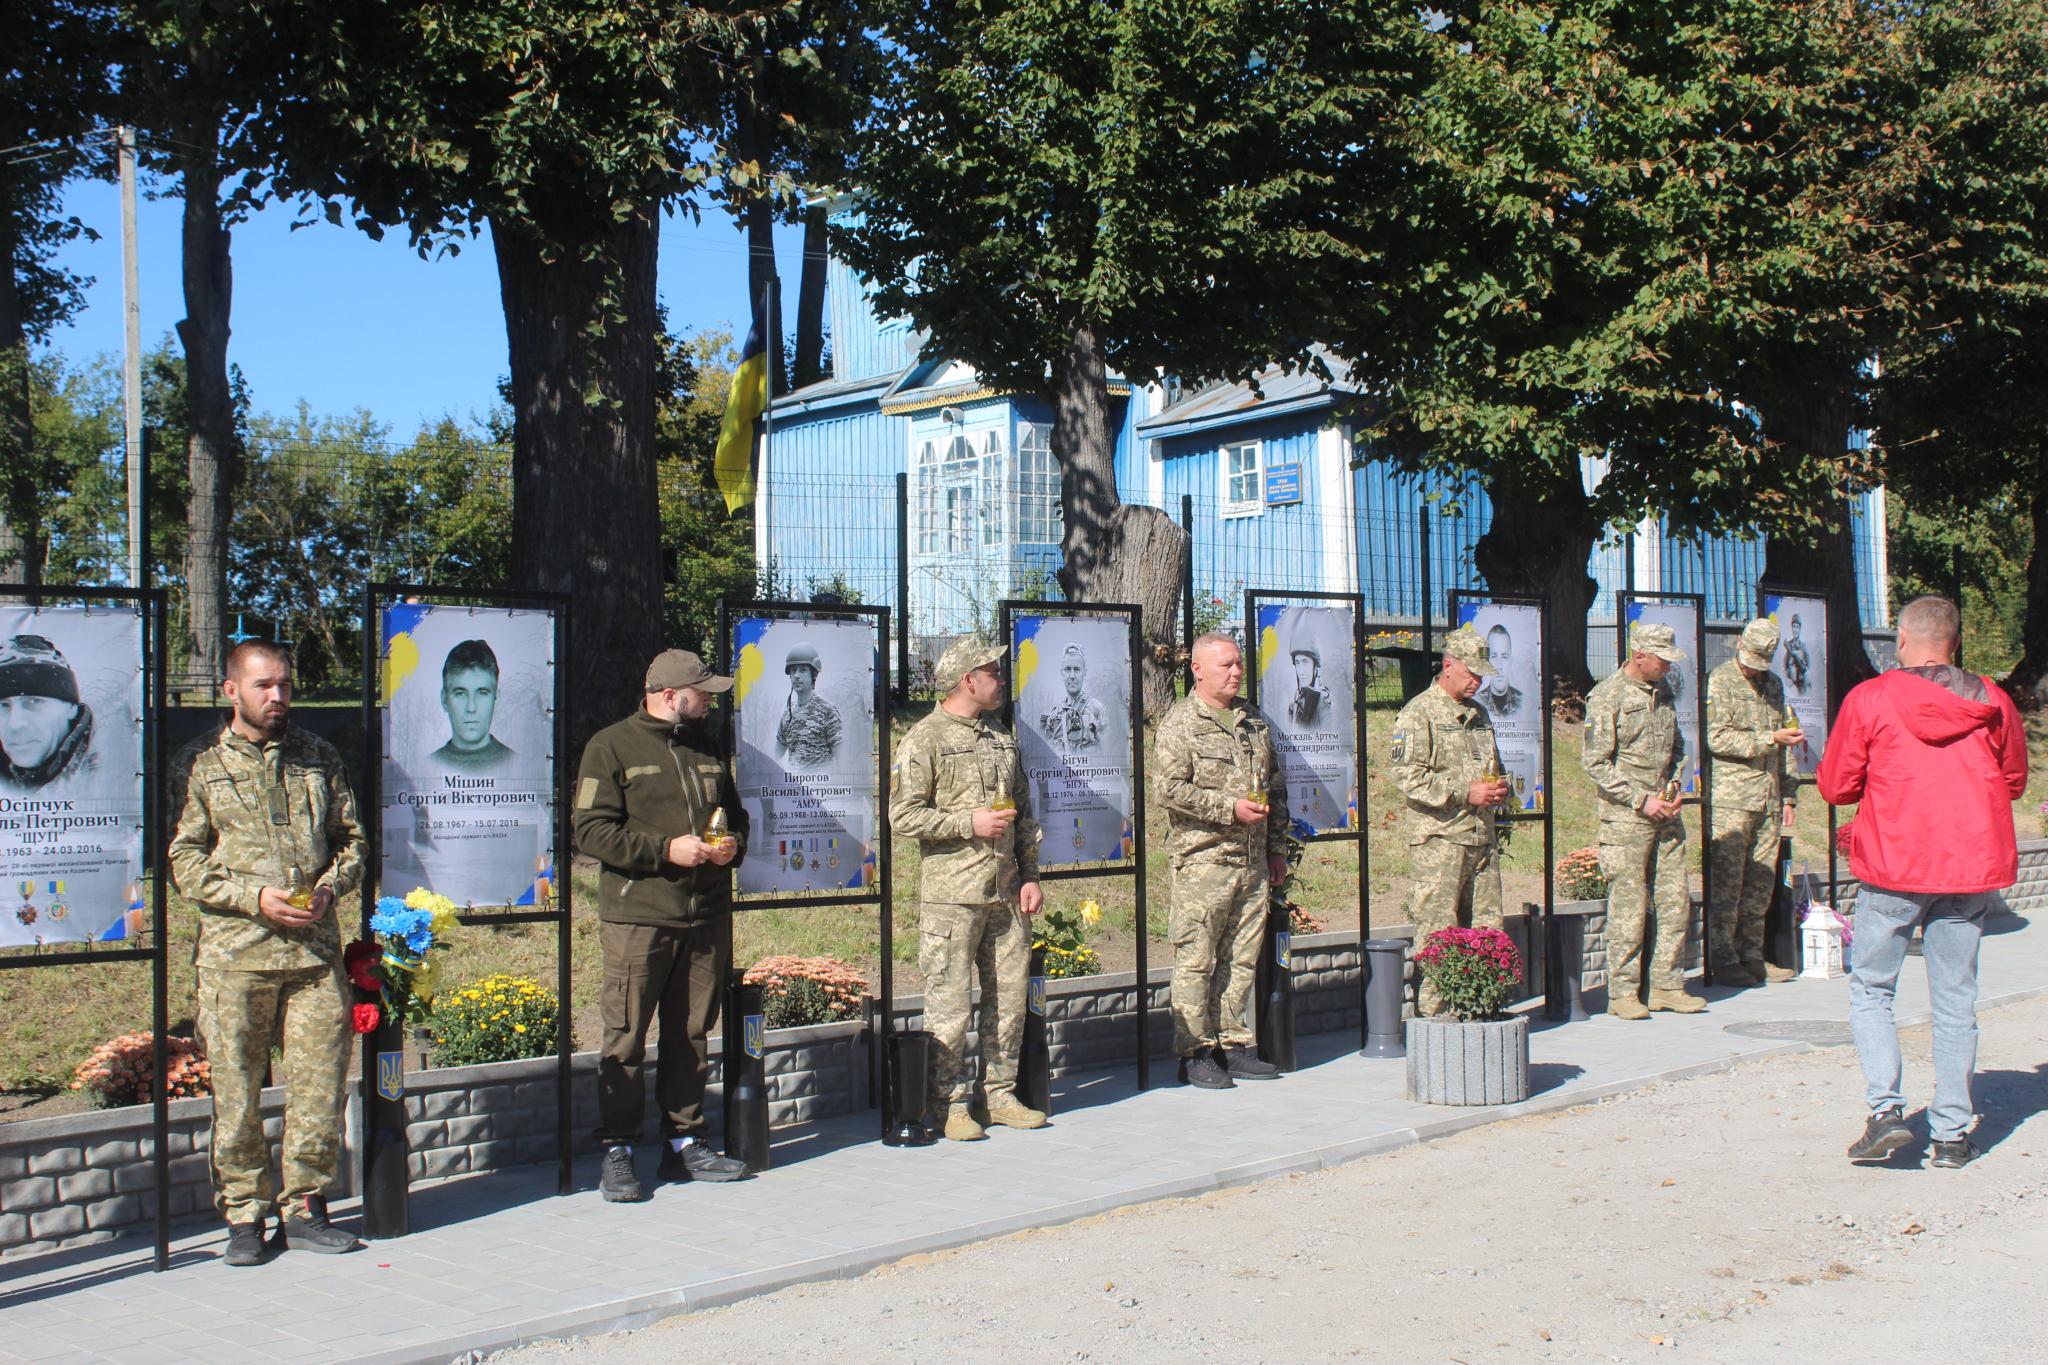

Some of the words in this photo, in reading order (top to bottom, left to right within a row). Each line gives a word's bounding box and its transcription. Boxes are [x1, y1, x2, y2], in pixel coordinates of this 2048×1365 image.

[1491, 721, 1516, 730] едорук
[1277, 732, 1313, 741] Москаль
[1315, 732, 1339, 742] Артем
[1276, 743, 1340, 754] Олександрович
[1062, 754, 1088, 767] Бігун
[784, 772, 830, 784] Пирогов
[1029, 767, 1062, 780] Сергій
[1065, 766, 1120, 780] Дмитрович
[444, 775, 495, 789] Мішин
[762, 786, 799, 797] Василь
[801, 785, 852, 798] Петрович
[398, 791, 447, 807] Сергій
[452, 790, 536, 806] Вікторович
[0, 797, 75, 815] Осіпчук
[26, 814, 120, 831] Петрович
[420, 820, 466, 830] 26.08.1967
[475, 819, 519, 828] 15.07.2018
[43, 844, 103, 856] 24.03.2016
